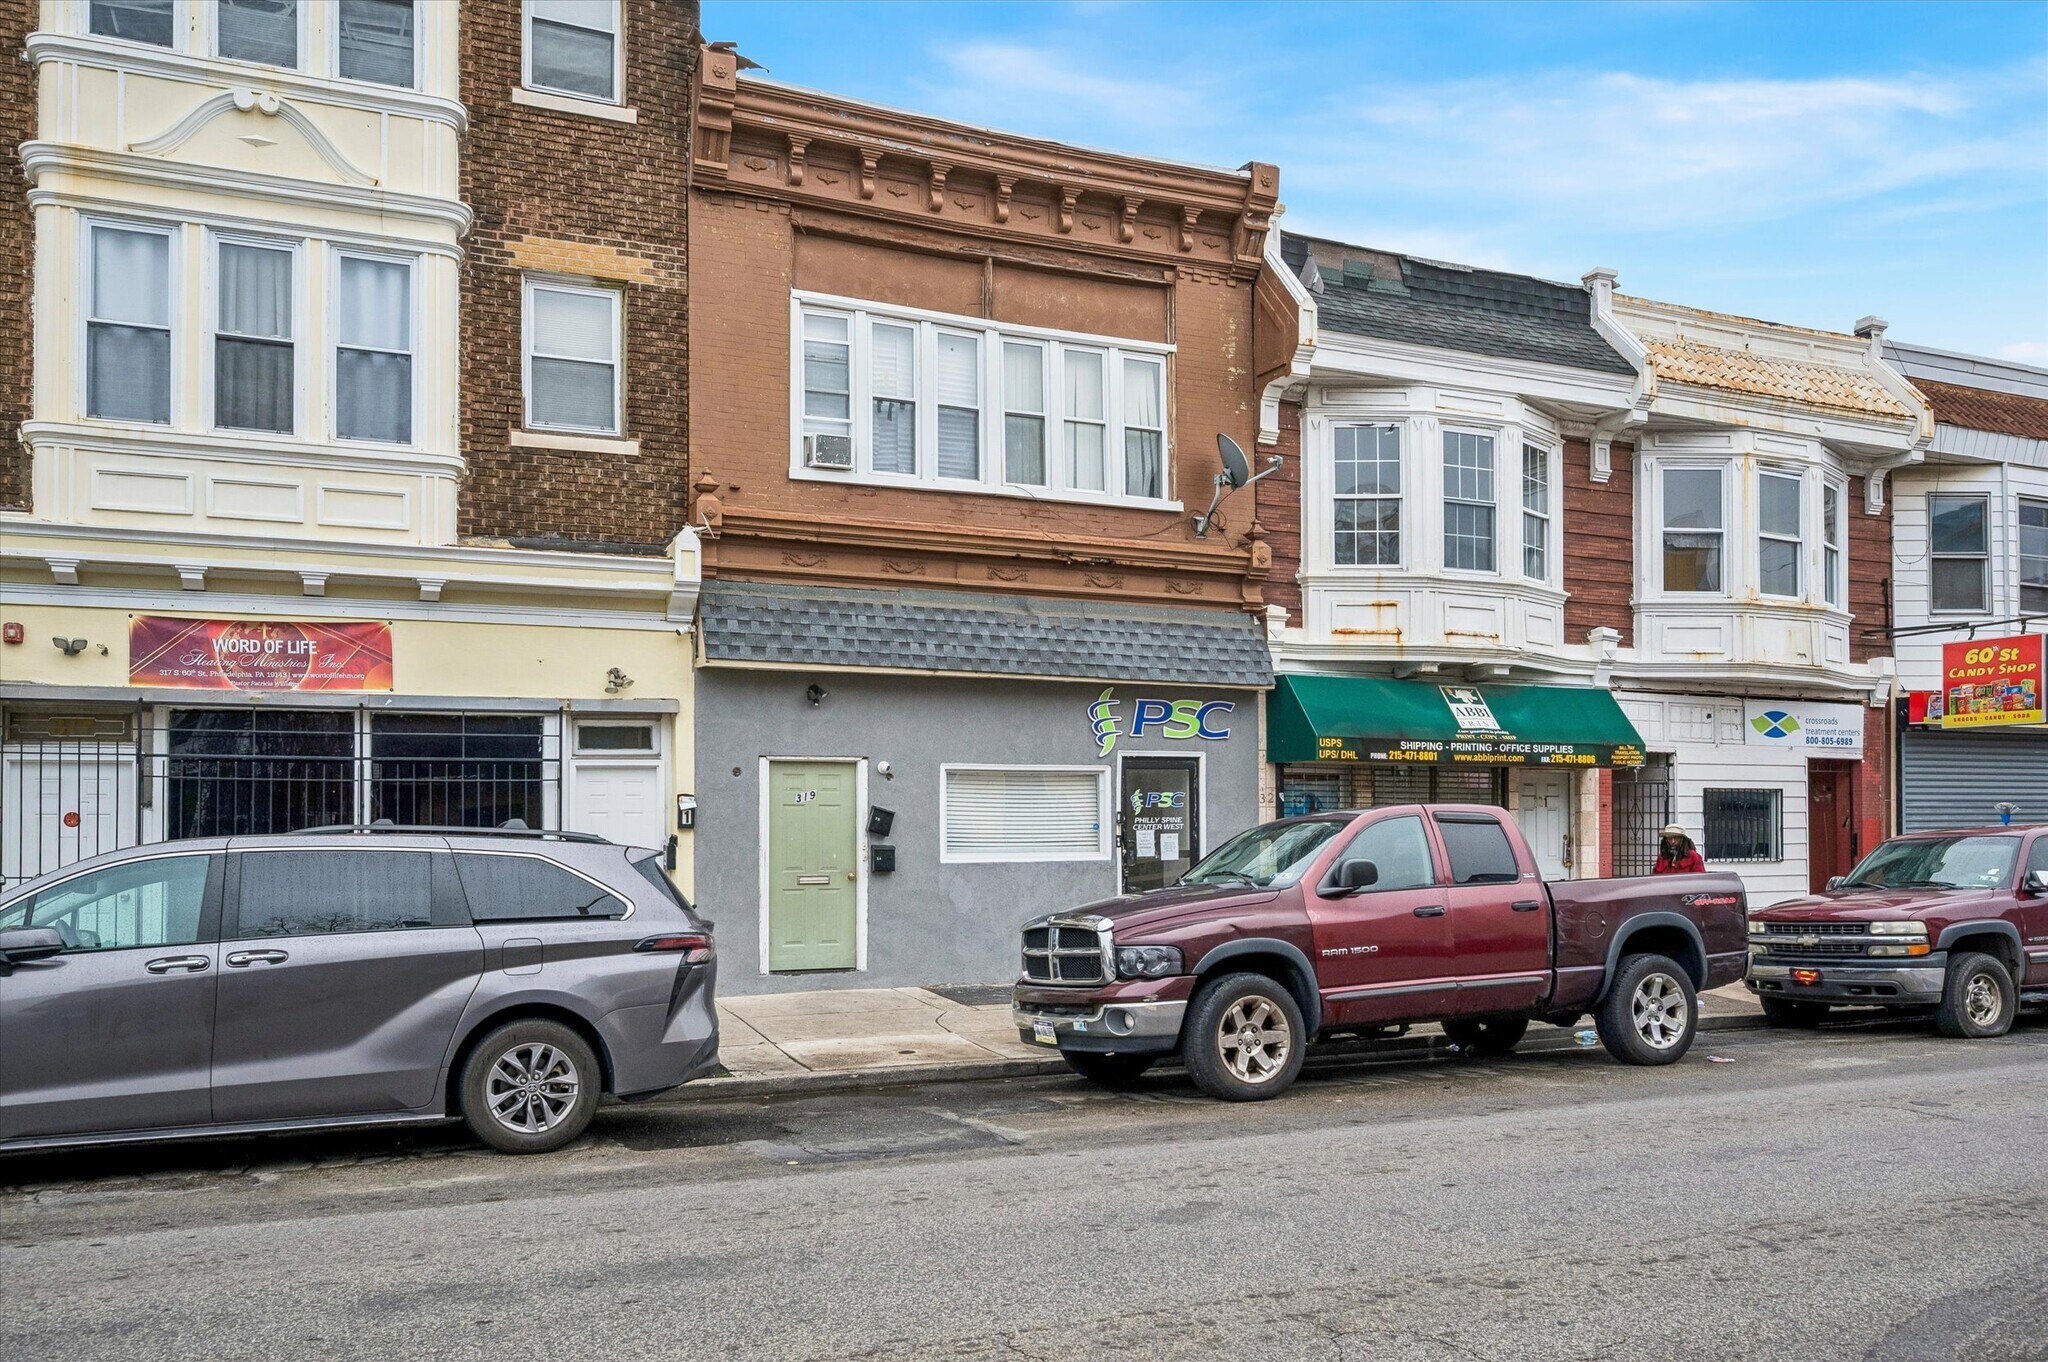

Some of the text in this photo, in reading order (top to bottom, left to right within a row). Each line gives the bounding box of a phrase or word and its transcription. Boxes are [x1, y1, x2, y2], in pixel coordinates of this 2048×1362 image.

[212, 638, 317, 654] WORD OF LIFE
[179, 648, 238, 672] Healing
[238, 651, 307, 668] Ministries
[159, 669, 171, 677] 317
[267, 671, 287, 679] 19143
[1949, 663, 2036, 678] CANDY SHOP
[1455, 706, 1491, 718] ABBI
[1130, 698, 1236, 740] PSC
[1460, 720, 1498, 728] PRINT
[1805, 717, 1838, 725] crossroads
[1805, 728, 1860, 737] treatment centers
[1319, 738, 1342, 747] USPS
[1805, 736, 1853, 746] 800-805-6989
[1400, 741, 1574, 754] SHIPPING PRINTING OFFICE SUPPLIES
[1319, 749, 1358, 760] UPS/ DHL
[1453, 753, 1525, 763] www.abbiprint.com
[795, 790, 816, 803] 319
[1145, 791, 1186, 808] PSC
[684, 810, 689, 824] 1
[1161, 816, 1183, 824] SPINE
[1132, 823, 1163, 831] CENTER
[1321, 945, 1379, 957] RAM 1500
